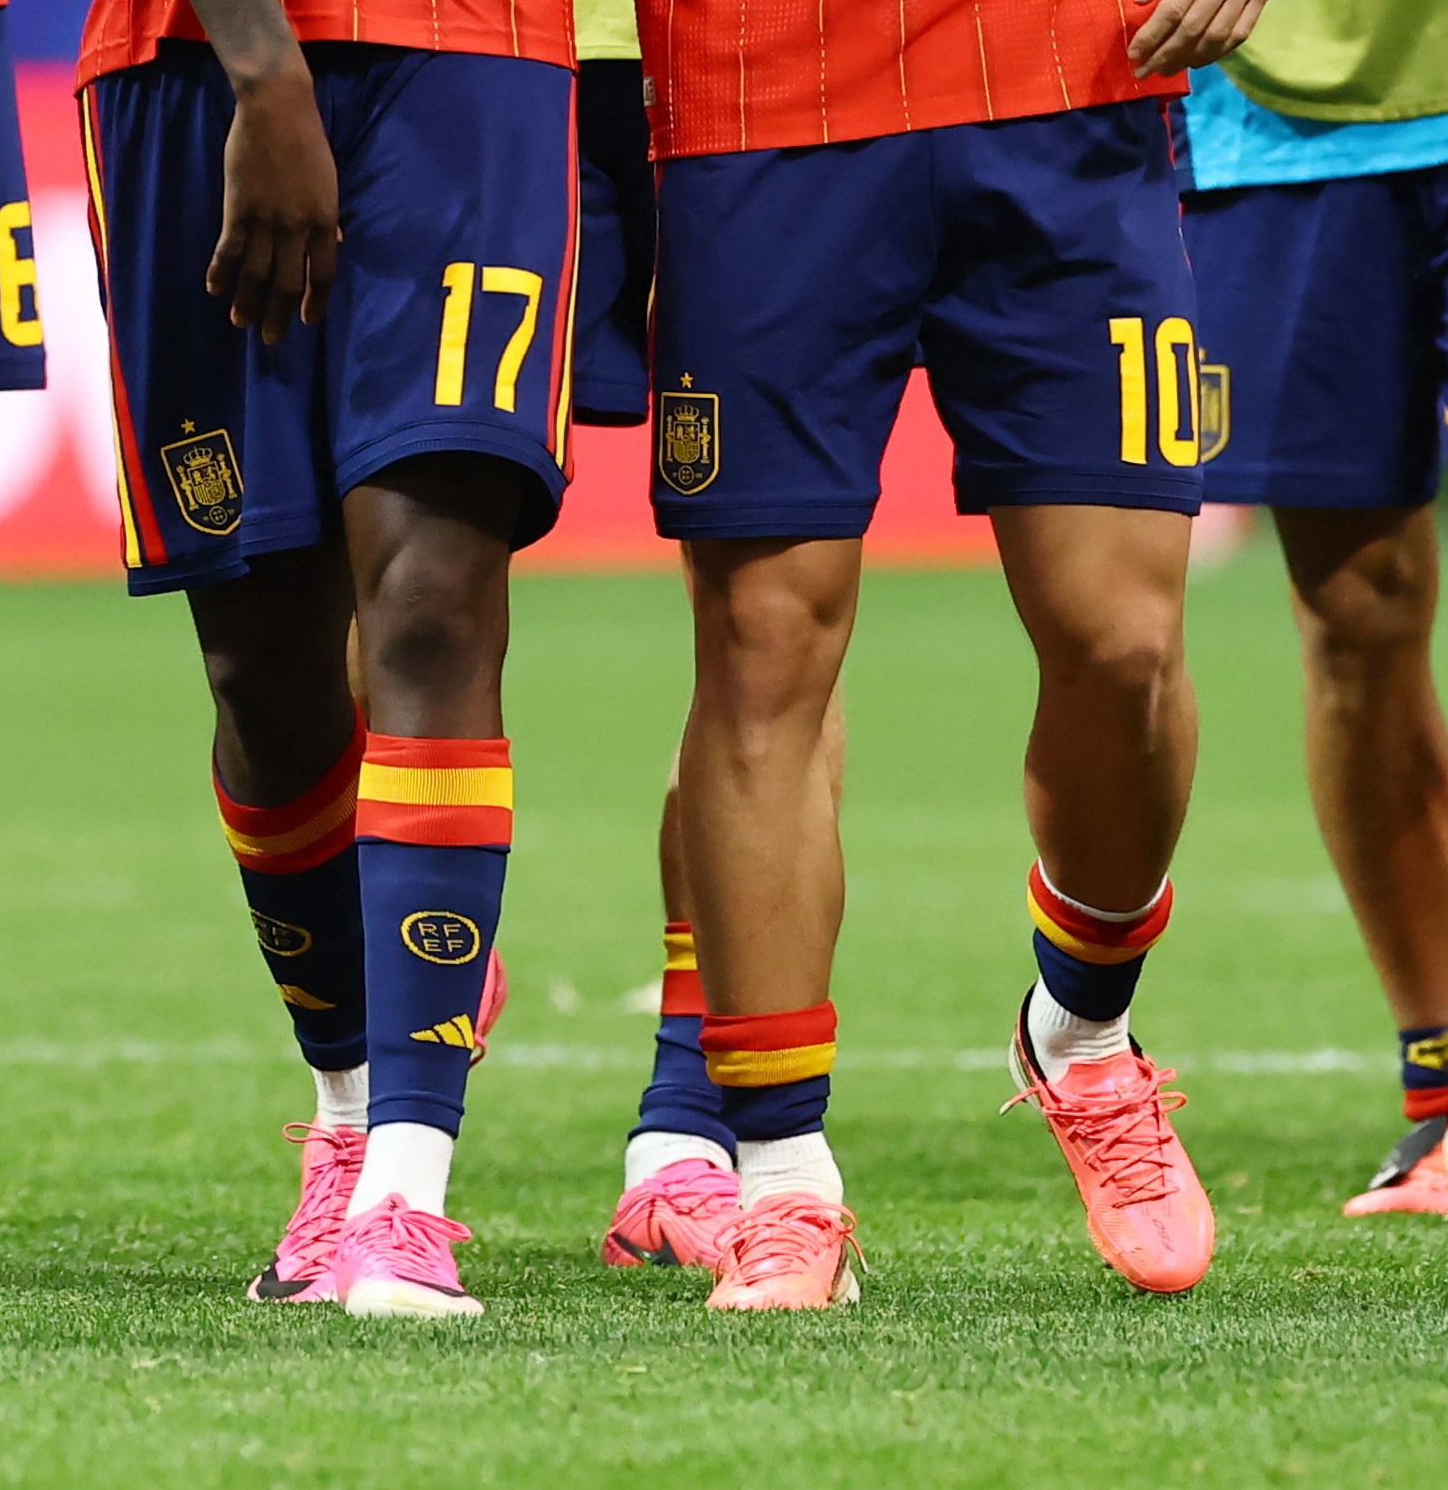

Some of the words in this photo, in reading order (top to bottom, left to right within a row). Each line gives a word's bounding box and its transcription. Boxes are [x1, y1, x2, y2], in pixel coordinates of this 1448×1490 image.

[435, 261, 545, 414] 17
[1107, 316, 1201, 467] 10
[417, 921, 461, 937] RF
[423, 938, 464, 952] EF
